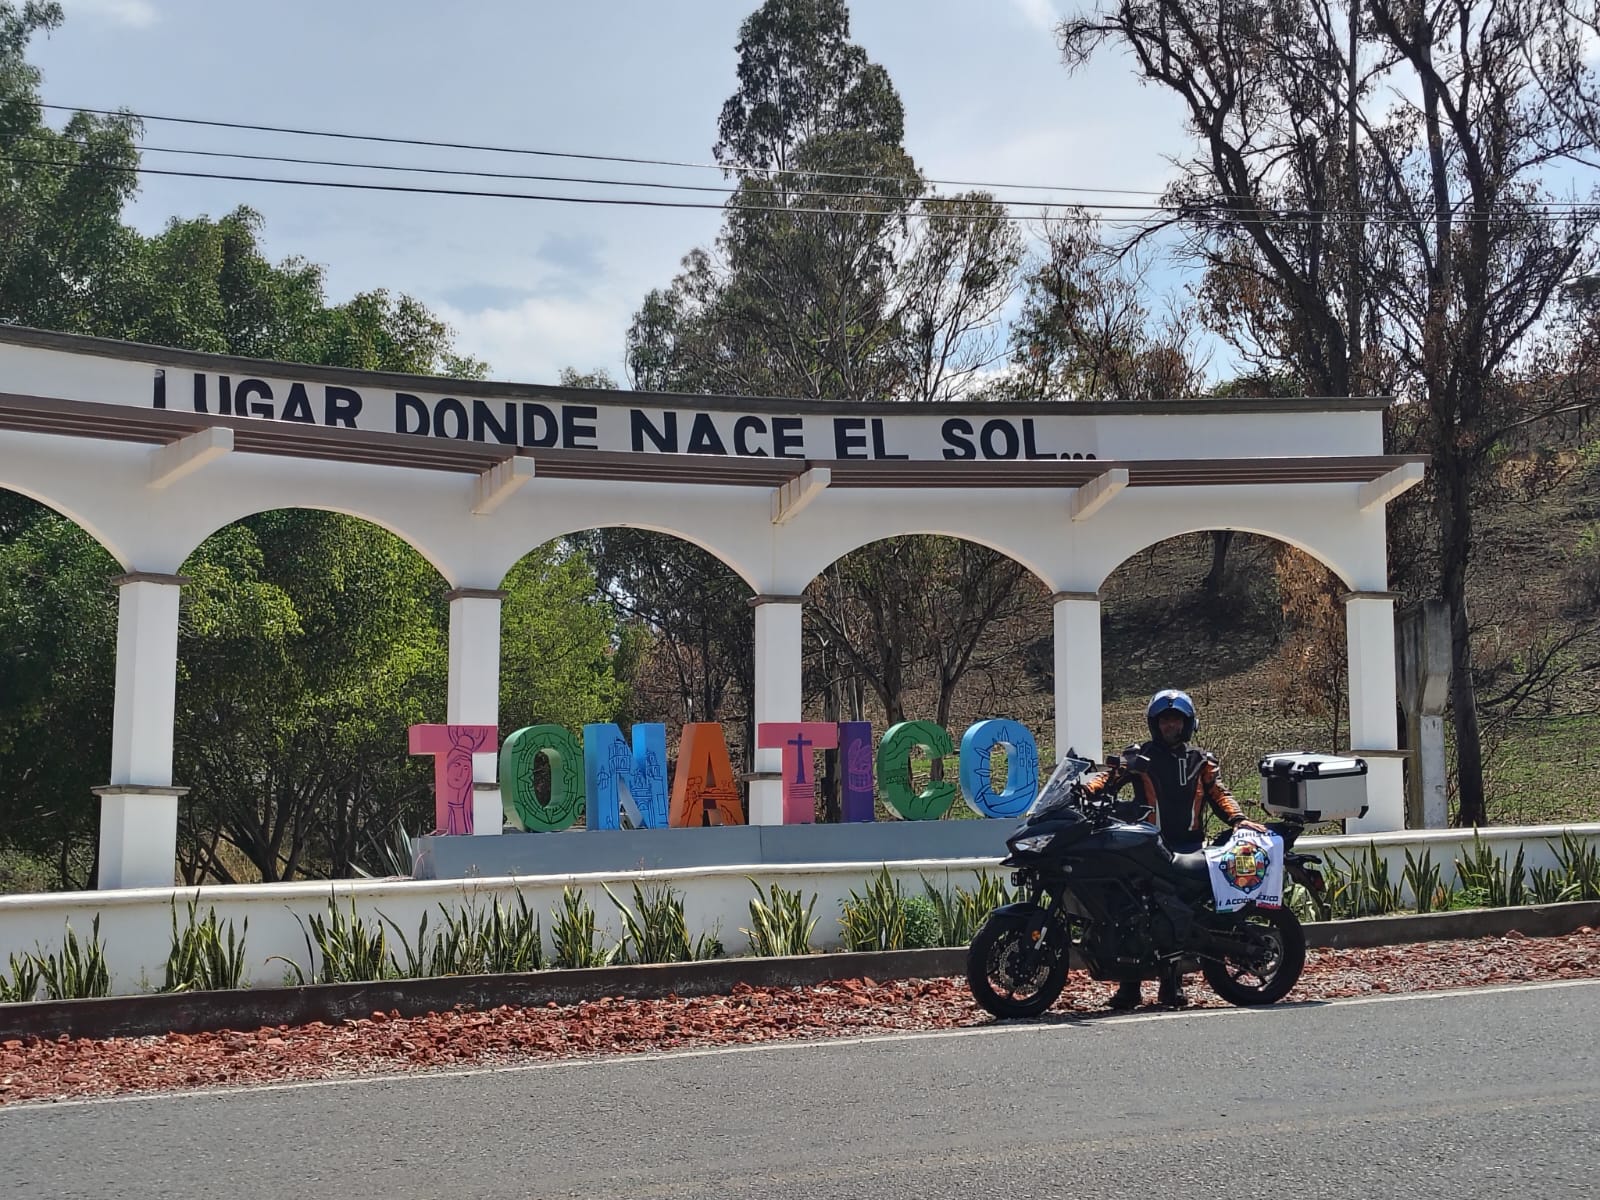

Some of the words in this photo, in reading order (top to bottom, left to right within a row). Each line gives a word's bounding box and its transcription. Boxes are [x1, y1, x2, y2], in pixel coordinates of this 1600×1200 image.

[395, 392, 599, 451] DONDE
[630, 408, 805, 459] NACE
[833, 417, 909, 461] EL
[408, 718, 1041, 836] TONATICO
